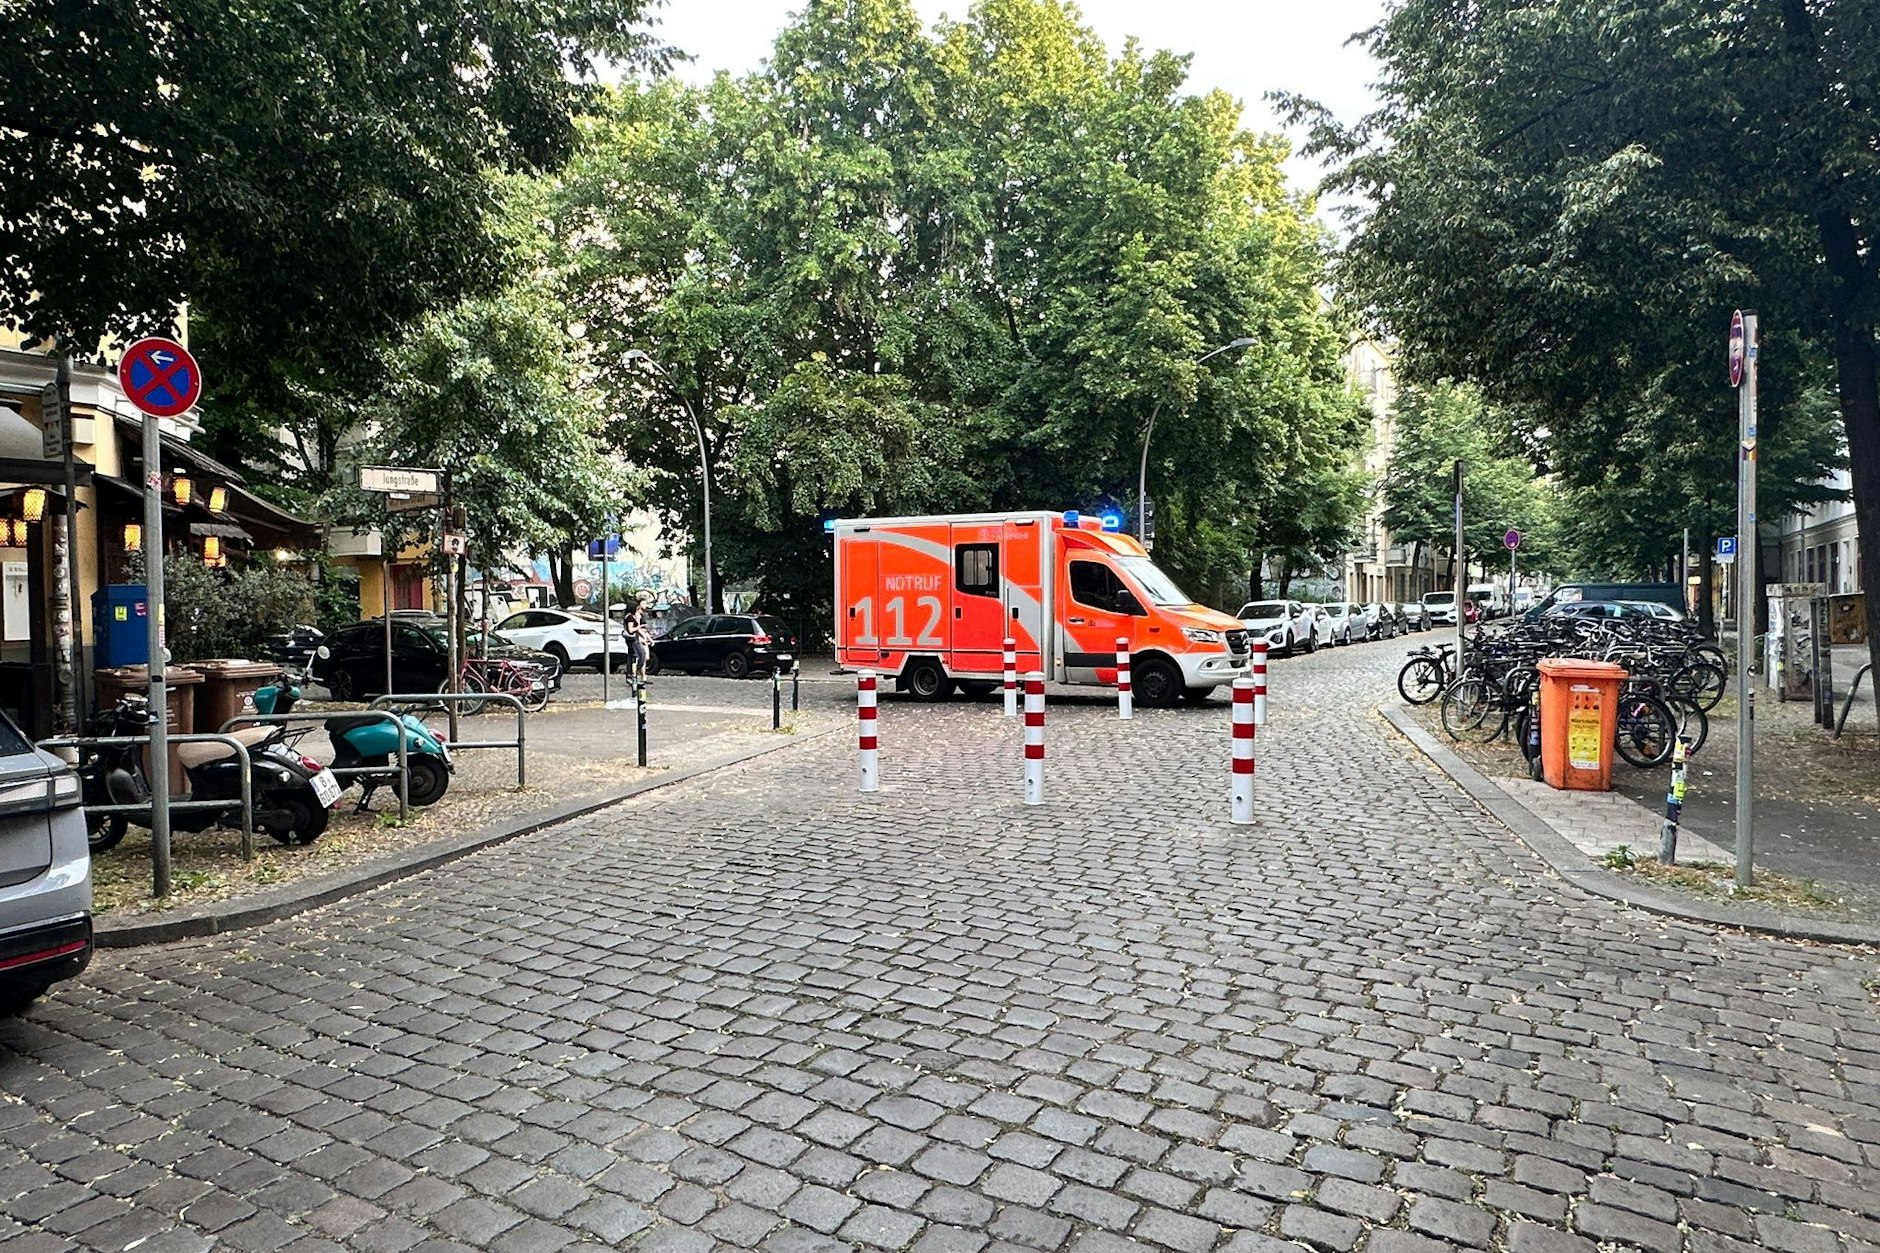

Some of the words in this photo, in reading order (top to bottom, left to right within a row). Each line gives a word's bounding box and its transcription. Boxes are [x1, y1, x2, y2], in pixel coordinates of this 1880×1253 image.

[1721, 540, 1732, 553] P
[885, 575, 942, 591] NOTRUF
[854, 596, 943, 646] 112
